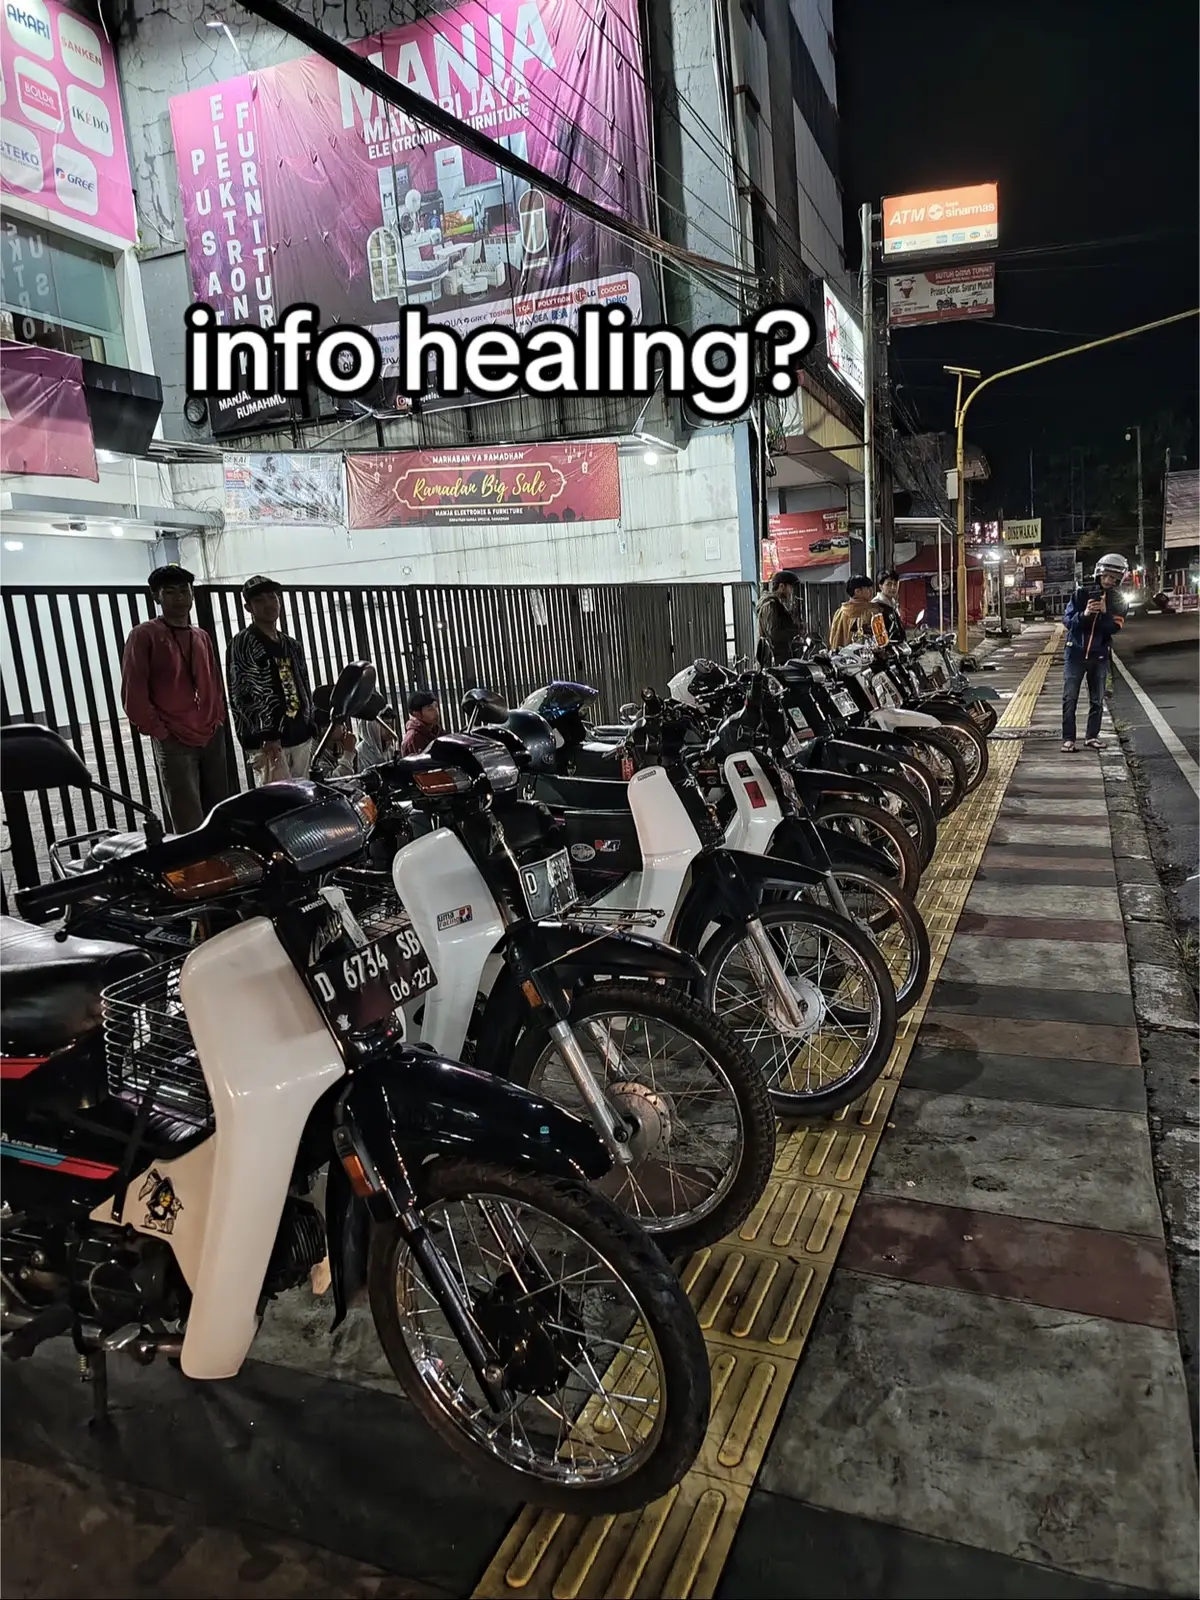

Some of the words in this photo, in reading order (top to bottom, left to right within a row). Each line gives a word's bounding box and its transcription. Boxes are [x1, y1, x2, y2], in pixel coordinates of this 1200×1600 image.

[7, 4, 51, 40] AKARI
[61, 36, 102, 67] SANKEN
[337, 2, 556, 129] MANJA
[469, 75, 531, 116] JAYA
[72, 105, 109, 134] IKEDO
[67, 173, 95, 193] GREE
[889, 207, 926, 226] ATM
[946, 203, 995, 218] sinarmas
[587, 289, 597, 298] LG
[432, 454, 470, 464] MARHABAN
[472, 454, 482, 463] YA
[484, 452, 524, 462] RAMADHAN
[413, 476, 478, 501] Ramadan
[482, 473, 508, 504] Big
[512, 470, 547, 497] Sale
[435, 509, 453, 517] MANJA
[493, 507, 523, 515] FURNITURE
[1007, 523, 1039, 540] DISEWAKAN
[525, 872, 537, 895] D
[314, 972, 336, 1002] D
[343, 943, 389, 989] 6734
[395, 929, 421, 960] SB
